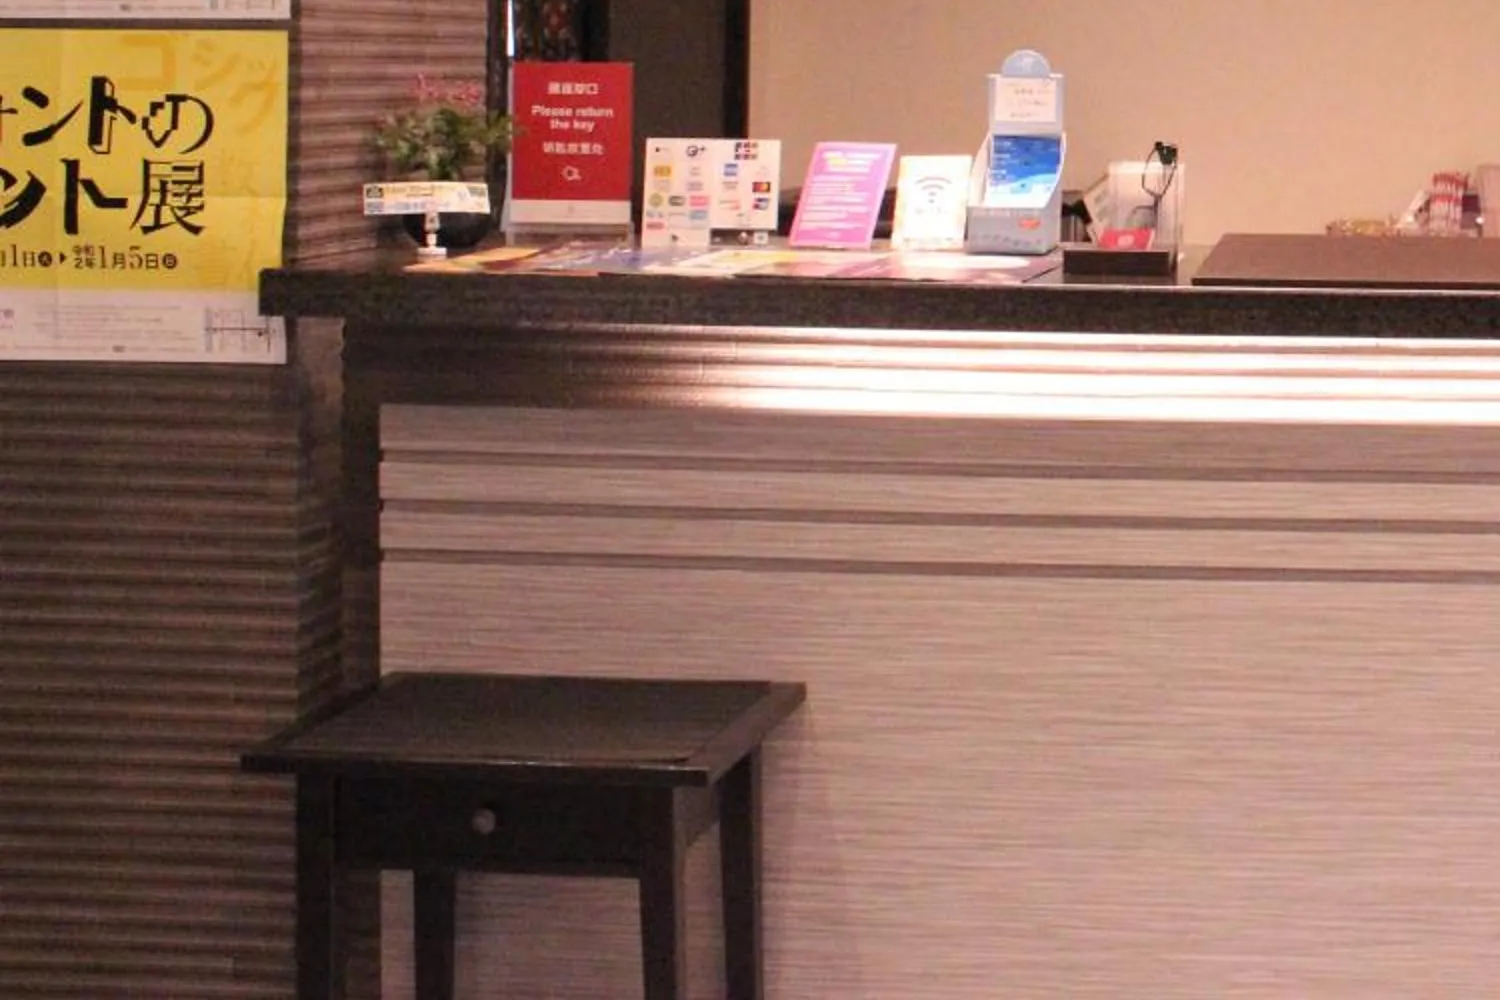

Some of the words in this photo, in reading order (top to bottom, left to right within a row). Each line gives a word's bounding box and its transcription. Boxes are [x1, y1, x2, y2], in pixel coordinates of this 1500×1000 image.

[531, 105, 573, 116] Please
[575, 107, 614, 117] return
[550, 119, 570, 129] the
[573, 119, 595, 132] key
